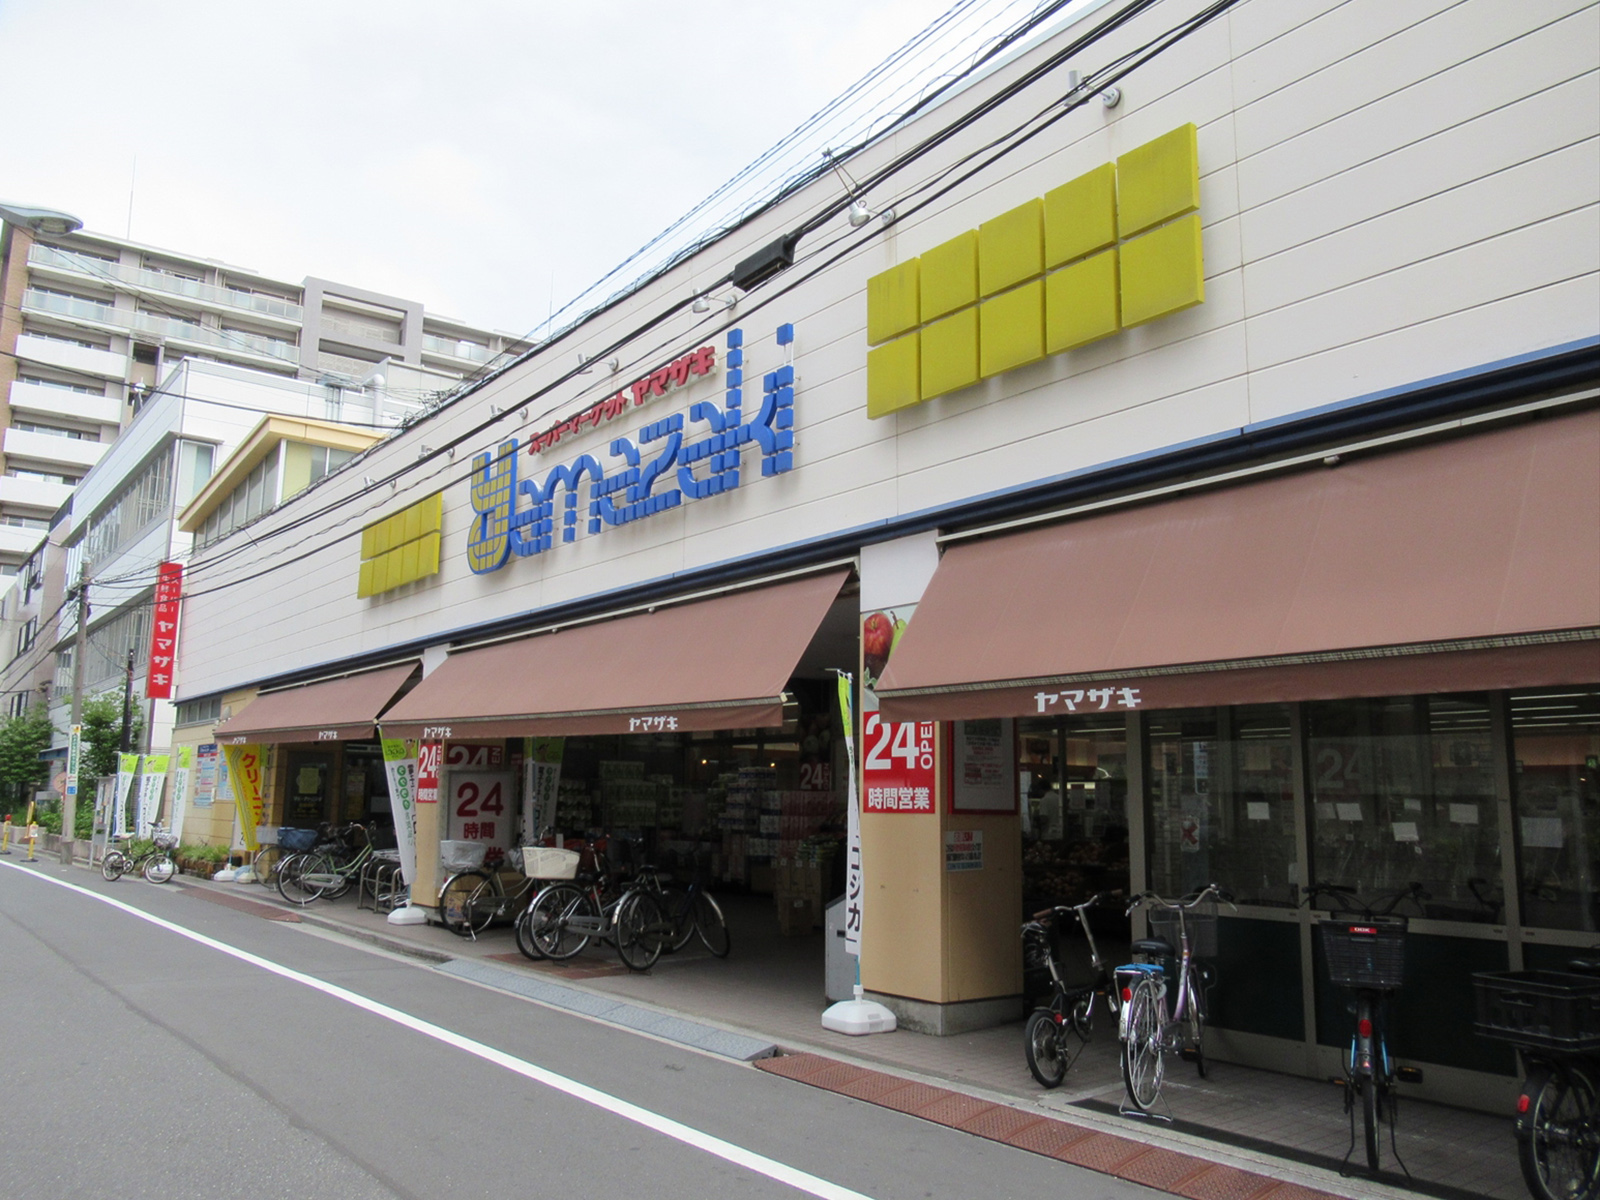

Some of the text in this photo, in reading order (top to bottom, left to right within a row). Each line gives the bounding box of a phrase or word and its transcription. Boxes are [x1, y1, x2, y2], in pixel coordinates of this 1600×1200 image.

[631, 345, 716, 406] ヤマザキ
[153, 620, 175, 686] ヤマザキ
[1034, 686, 1142, 712] ヤマザキ
[318, 731, 338, 740] ヤマザキ
[423, 726, 452, 738] ヤマザキ
[628, 715, 678, 732] ヤマザキ
[864, 713, 920, 770] 24
[418, 745, 437, 779] 24
[800, 763, 824, 790] 24
[456, 781, 504, 817] 24
[867, 786, 930, 810] 時間営業
[463, 822, 495, 840] 時間
